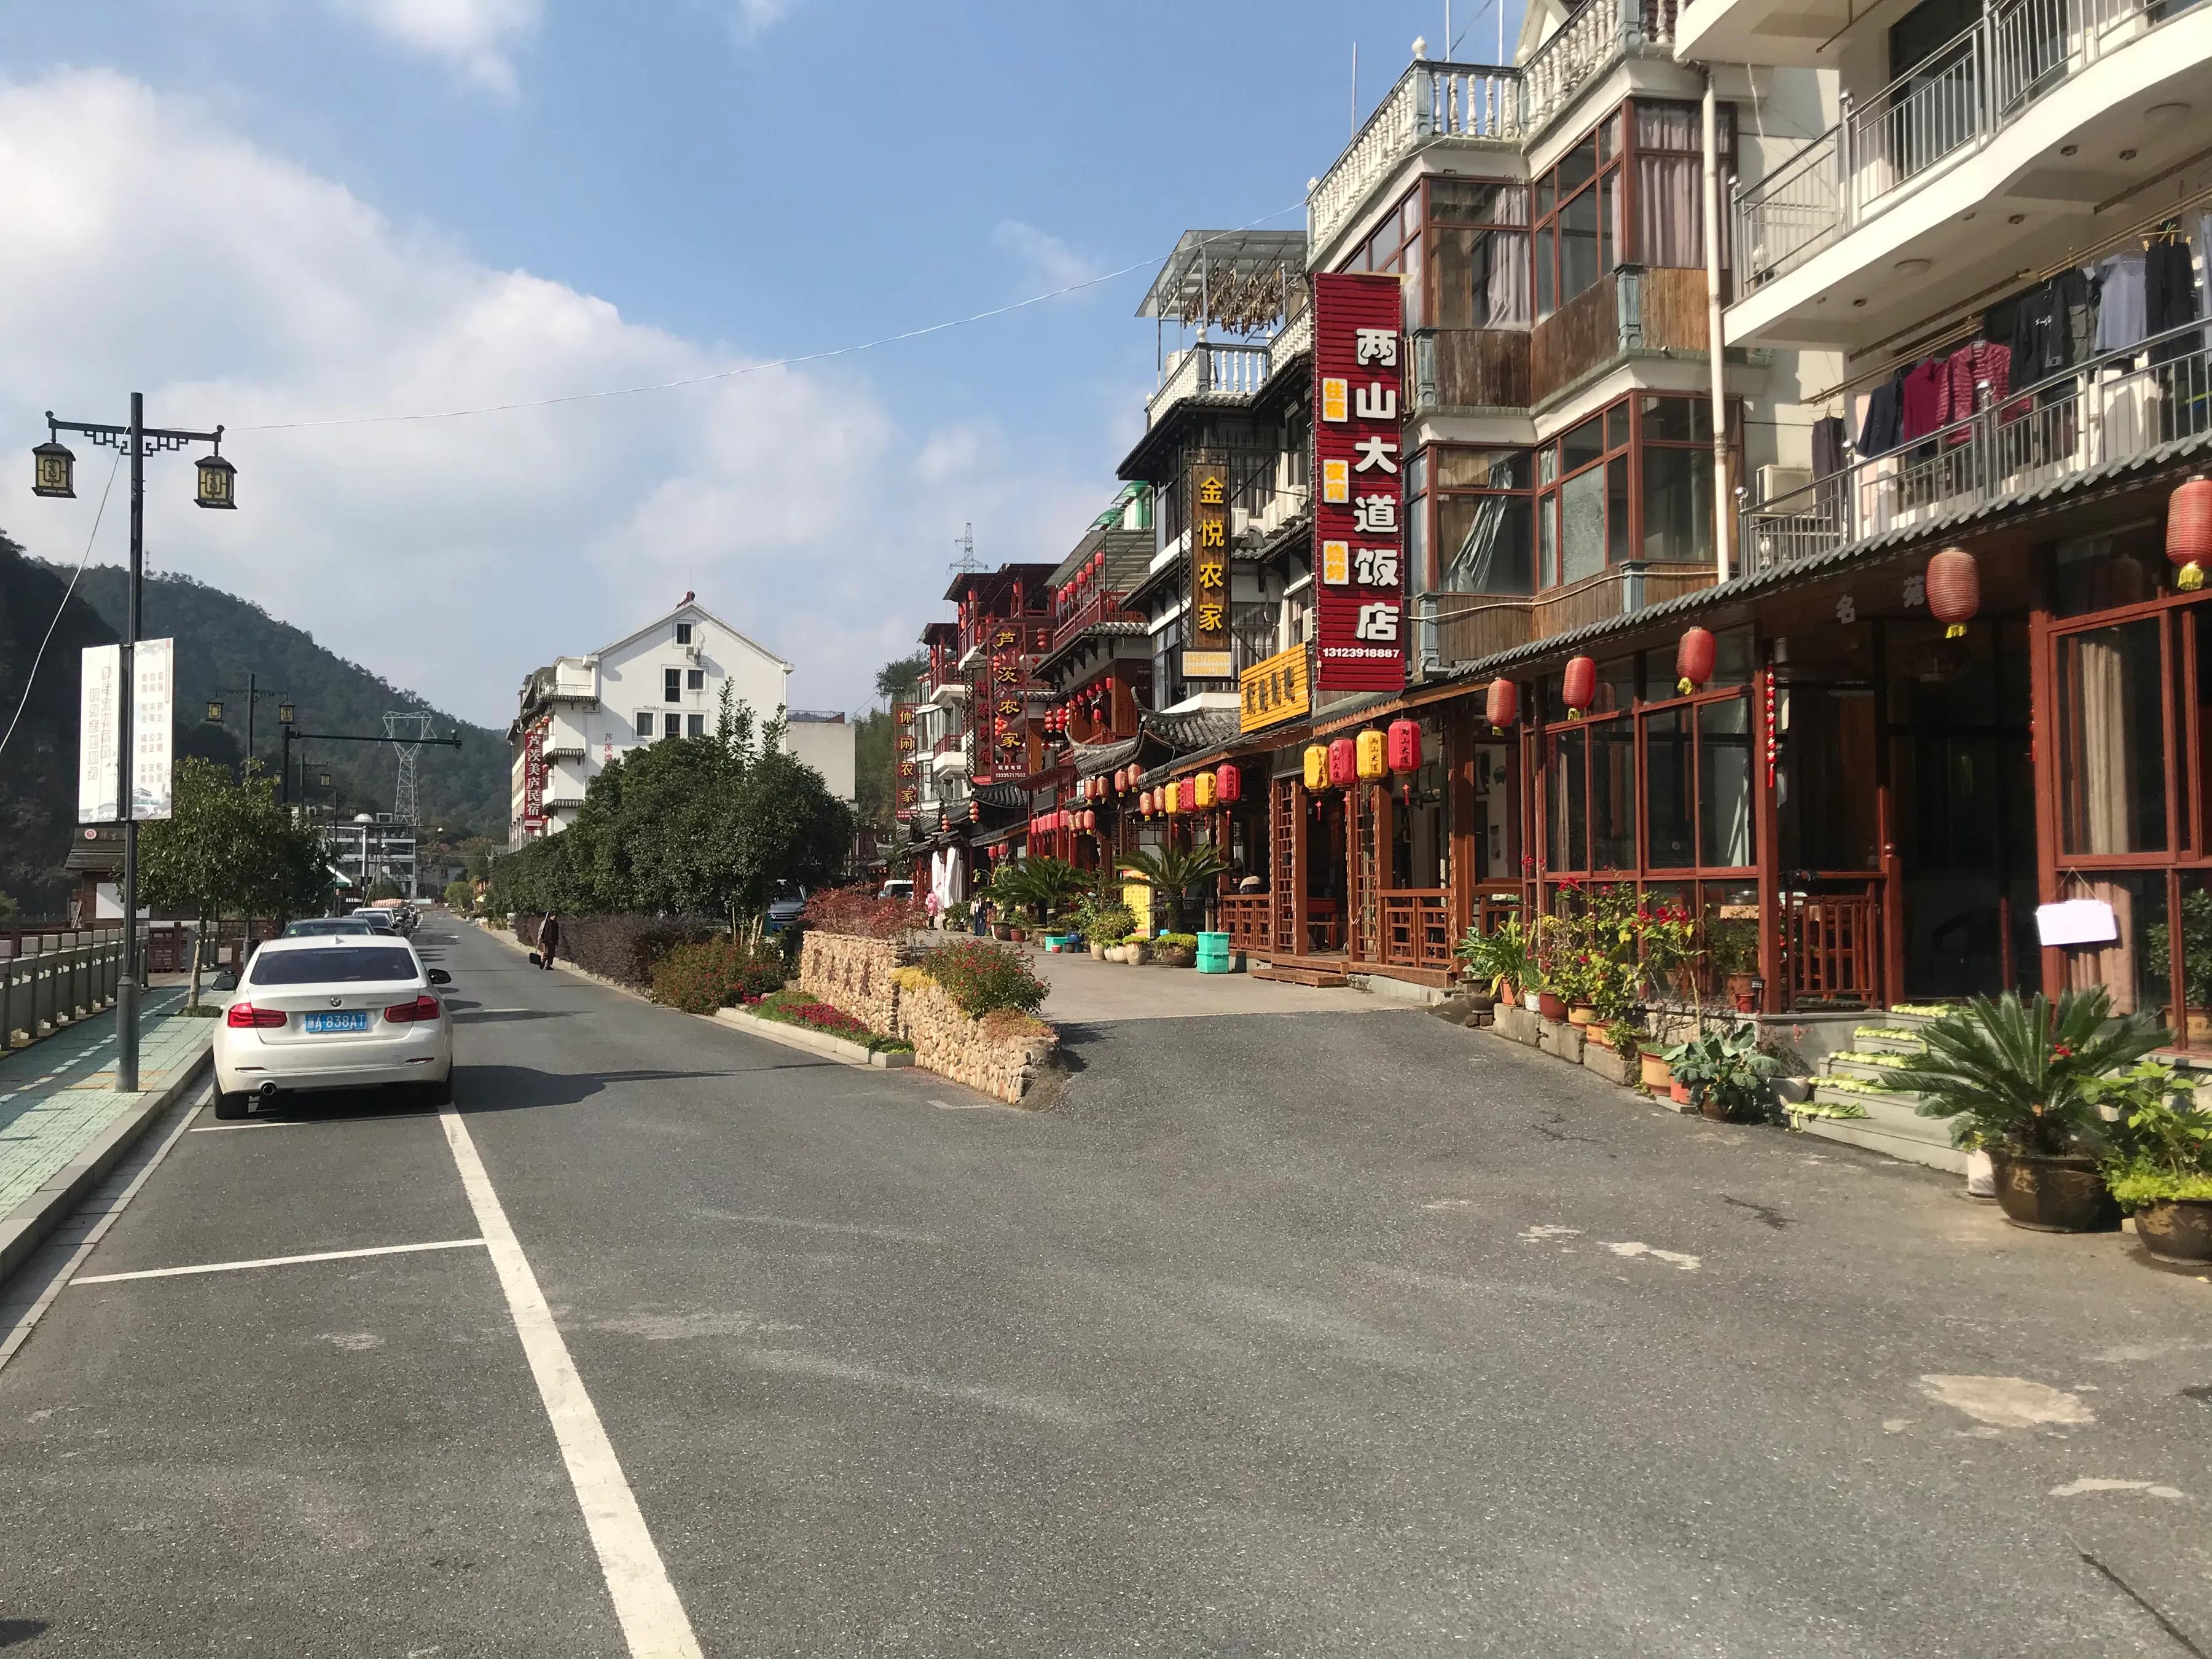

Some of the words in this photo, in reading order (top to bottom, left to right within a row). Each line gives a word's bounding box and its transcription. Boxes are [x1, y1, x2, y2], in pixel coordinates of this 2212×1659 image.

[1324, 381, 1346, 419] 住宿
[1325, 463, 1346, 500] 夜宵
[1354, 328, 1399, 641] 两山大道饭店
[1199, 476, 1225, 632] 金悦农家
[1326, 544, 1346, 581] 烧烤
[996, 632, 1021, 748] 芦茨农家
[1322, 647, 1400, 659] 13123918887
[527, 735, 541, 816] 芦茨美庐民宿
[900, 710, 914, 803] 休闲农家
